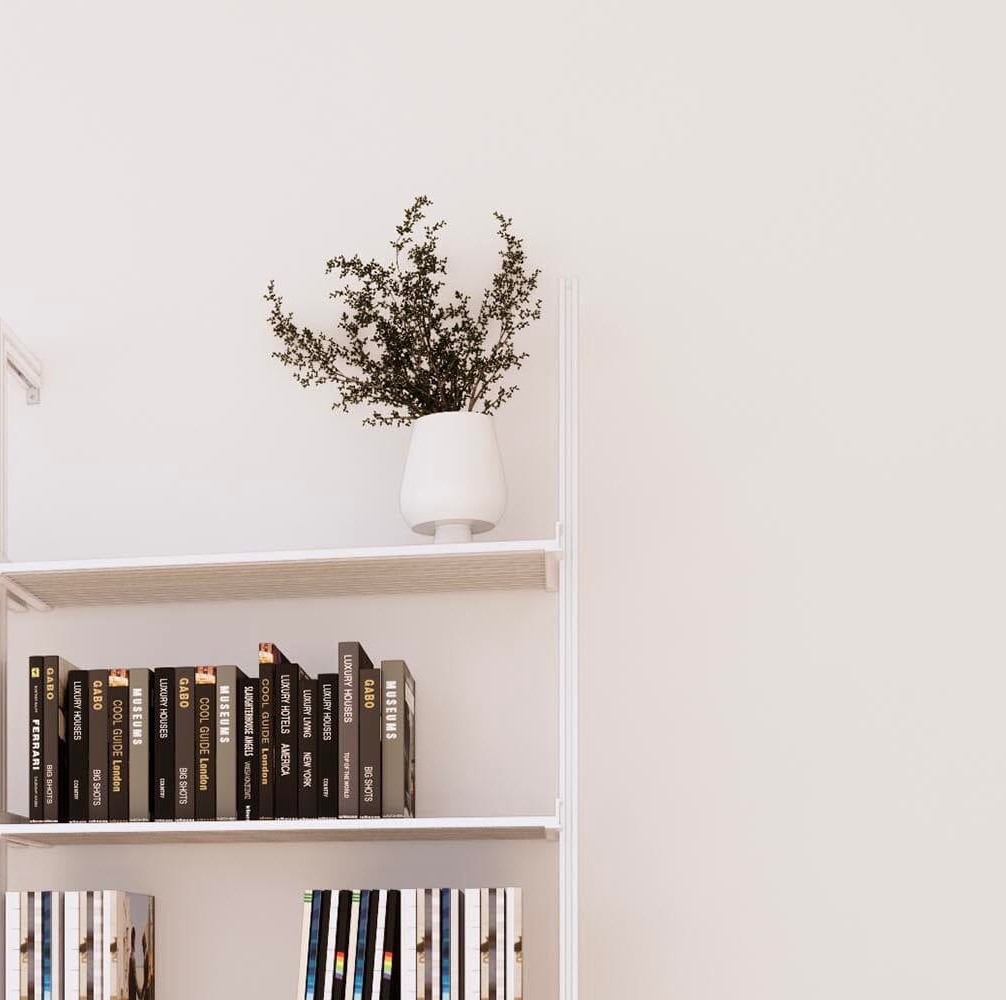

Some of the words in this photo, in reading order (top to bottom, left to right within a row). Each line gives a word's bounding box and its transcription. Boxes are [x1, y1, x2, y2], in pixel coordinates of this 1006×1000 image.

[46, 667, 54, 700] GABO
[344, 655, 353, 688] LUXURY
[93, 680, 103, 711] GABO
[160, 678, 168, 708] LUXURY
[179, 677, 189, 708] GABO
[281, 675, 290, 704] LUXURY
[303, 689, 311, 715] LUXURY
[323, 684, 331, 712] LUXURY
[364, 679, 375, 709] GABO
[113, 700, 123, 725] COOL
[132, 688, 142, 745] MUSEUMS
[199, 697, 209, 723] COOL
[219, 685, 230, 743] MUSEUMS
[281, 705, 290, 734] HOTELS
[344, 689, 353, 723] HOUSES
[385, 680, 397, 739] MUSEUMS
[160, 709, 168, 739] HOUSES
[303, 716, 311, 738] LIVING
[323, 713, 331, 741] HOUSES
[32, 719, 40, 770] FERRARI
[113, 728, 123, 756] GUIDE
[199, 726, 209, 754] GUIDE
[179, 767, 188, 779] BIG
[281, 743, 290, 777] AMERICA
[303, 752, 311, 767] NEW
[364, 766, 373, 778] BIG
[93, 769, 101, 781] BIG
[113, 760, 123, 792] London
[199, 758, 209, 791] London
[303, 768, 311, 788] YORK
[93, 782, 101, 806] SHOTS
[179, 781, 188, 805] SHOTS
[364, 779, 373, 802] SHOTS
